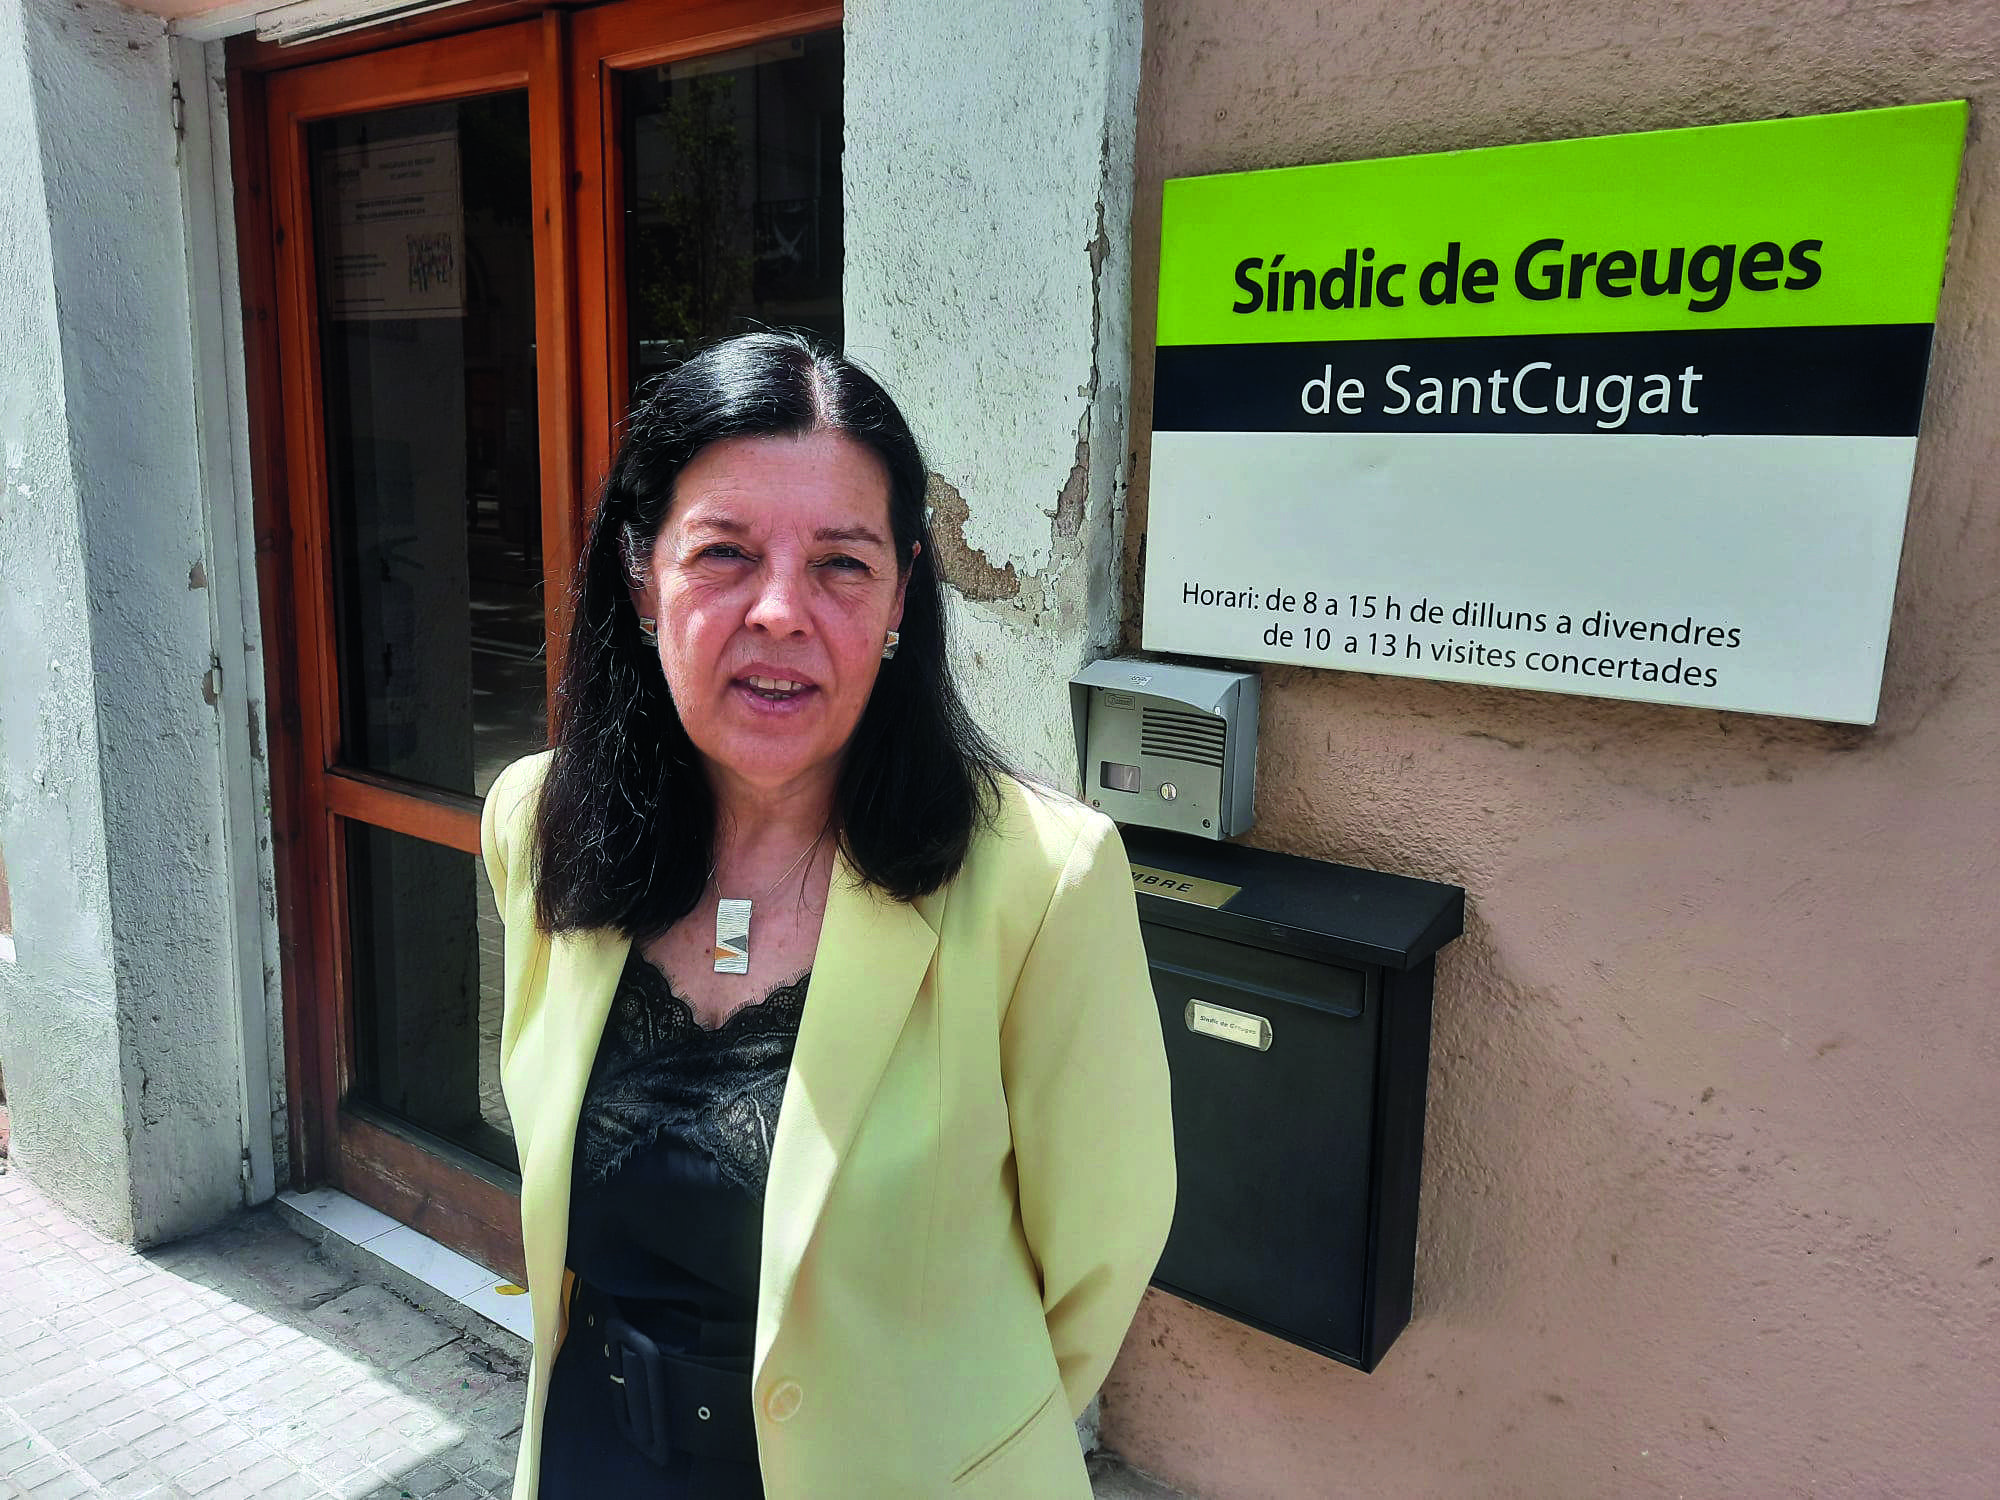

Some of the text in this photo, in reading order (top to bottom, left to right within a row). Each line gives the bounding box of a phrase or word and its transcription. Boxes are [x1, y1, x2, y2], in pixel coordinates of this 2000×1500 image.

[1232, 238, 1824, 314] Síndic de Greuges
[1301, 364, 1365, 415] de
[1183, 582, 1741, 649] Horari: de 8 a 15 h de dilluns a divendres
[1263, 622, 1718, 688] de 10 a 13 h visites concertades
